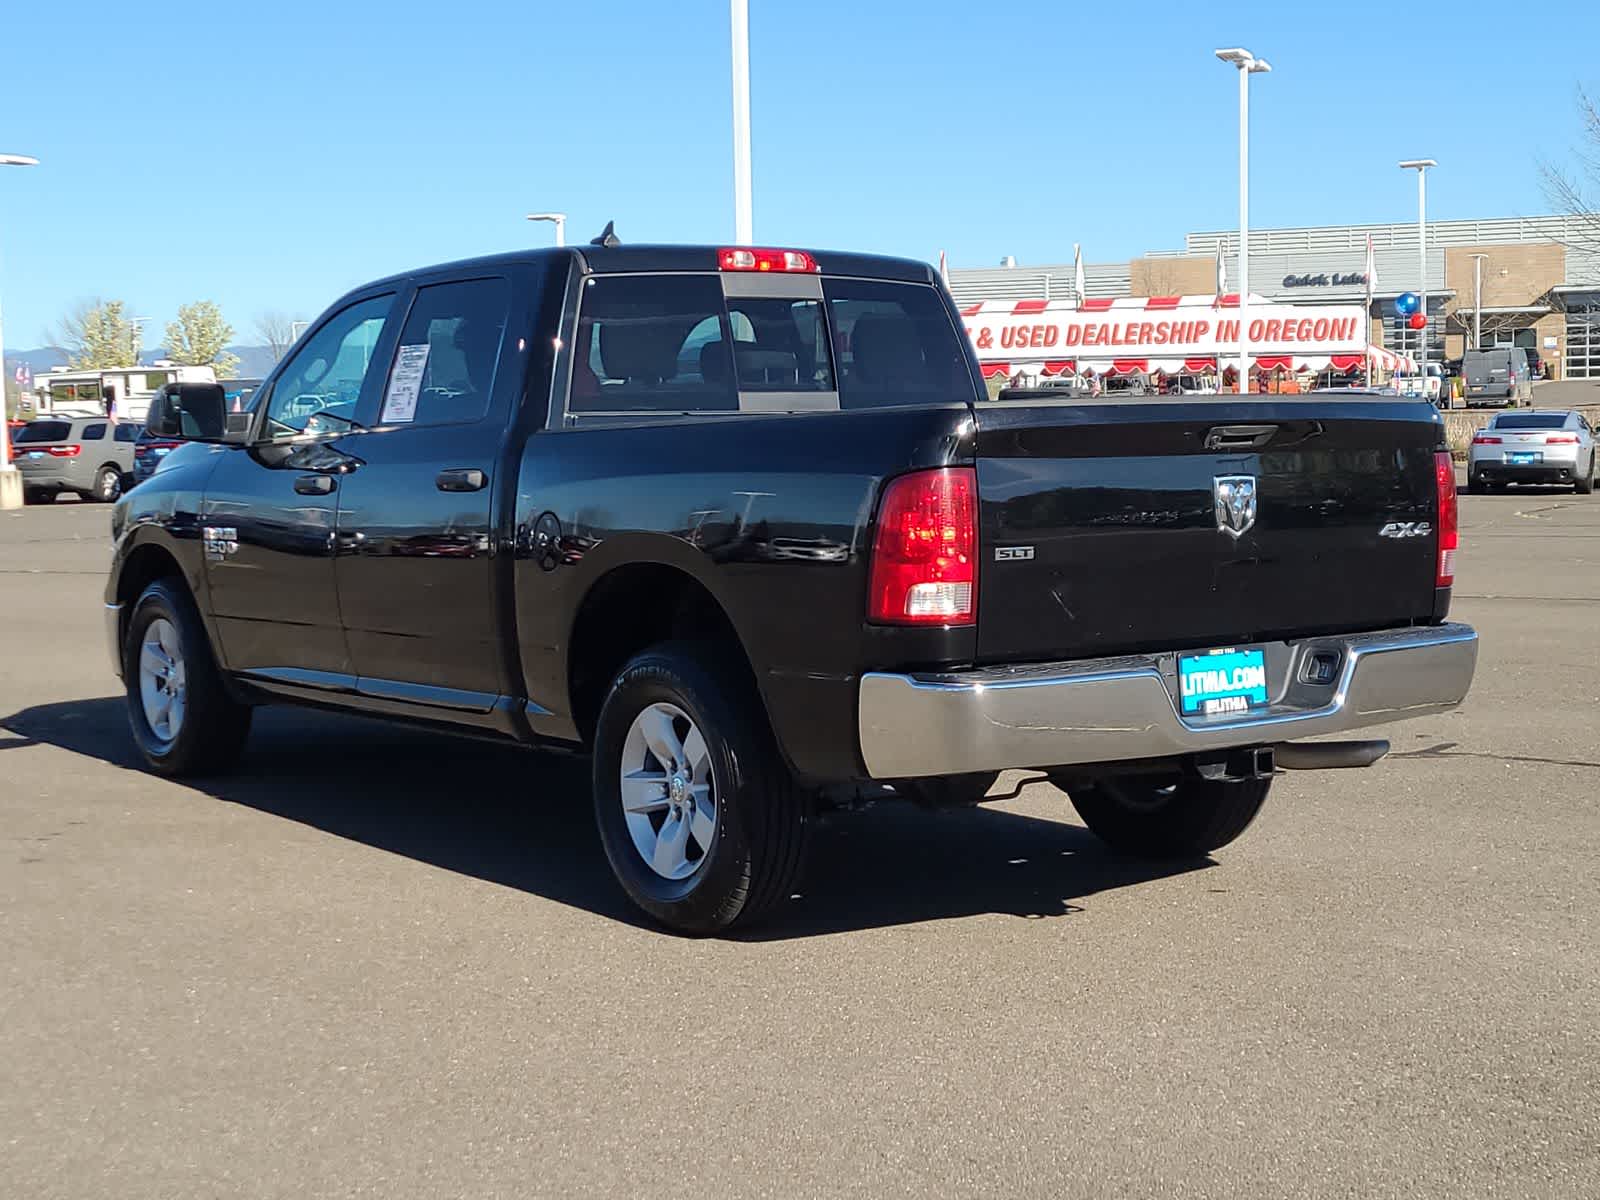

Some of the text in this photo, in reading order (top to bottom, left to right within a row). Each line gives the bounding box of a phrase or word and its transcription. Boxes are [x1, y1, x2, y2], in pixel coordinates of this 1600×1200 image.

[976, 327, 993, 348] &
[1000, 325, 1060, 349] USED
[1066, 320, 1210, 347] DEALERSHIP
[1215, 319, 1240, 343] IN
[1248, 317, 1357, 343] OREGON!
[998, 548, 1033, 560] SLT
[1181, 664, 1266, 697] LITHIA.COM
